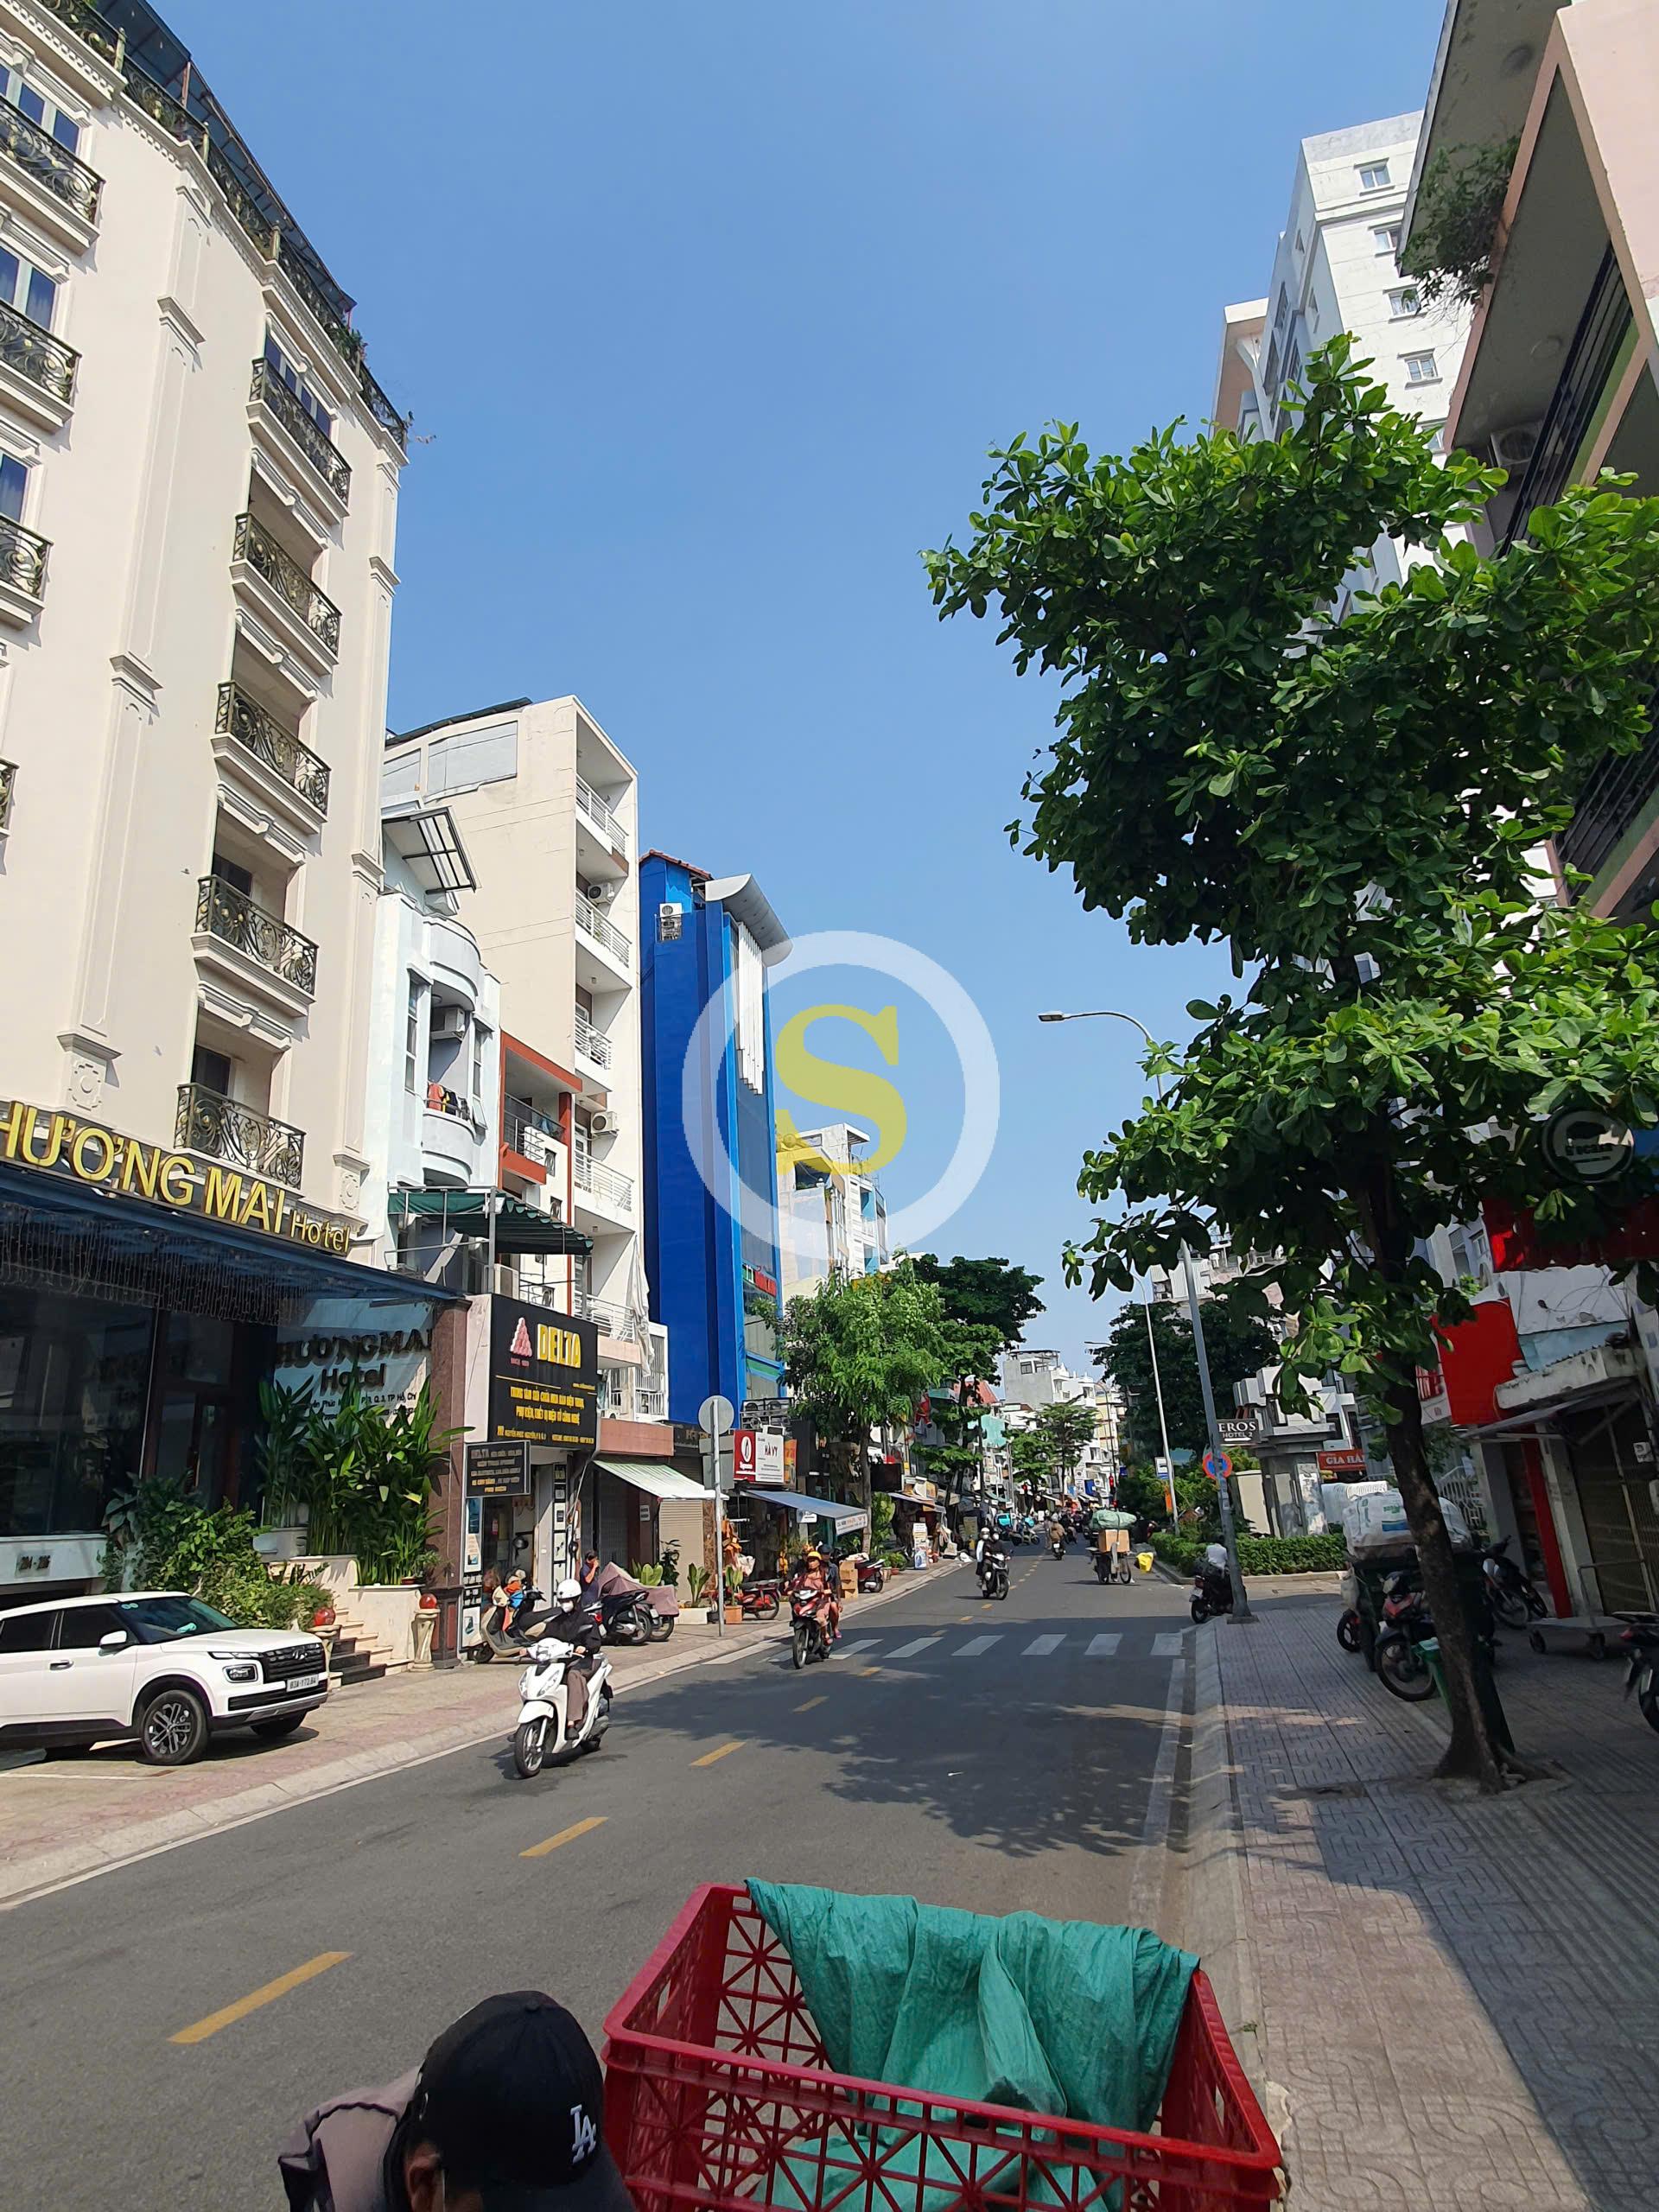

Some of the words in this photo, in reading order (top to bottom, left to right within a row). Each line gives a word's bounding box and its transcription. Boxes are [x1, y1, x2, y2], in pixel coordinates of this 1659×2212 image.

[205, 1166, 285, 1234] MAI
[290, 1210, 351, 1252] Hotel
[537, 1324, 582, 1369] DELTA
[321, 1363, 386, 1393] Hotel
[1218, 1421, 1256, 1433] EROS
[1325, 1456, 1345, 1465] GIA
[570, 2103, 596, 2164] LA
